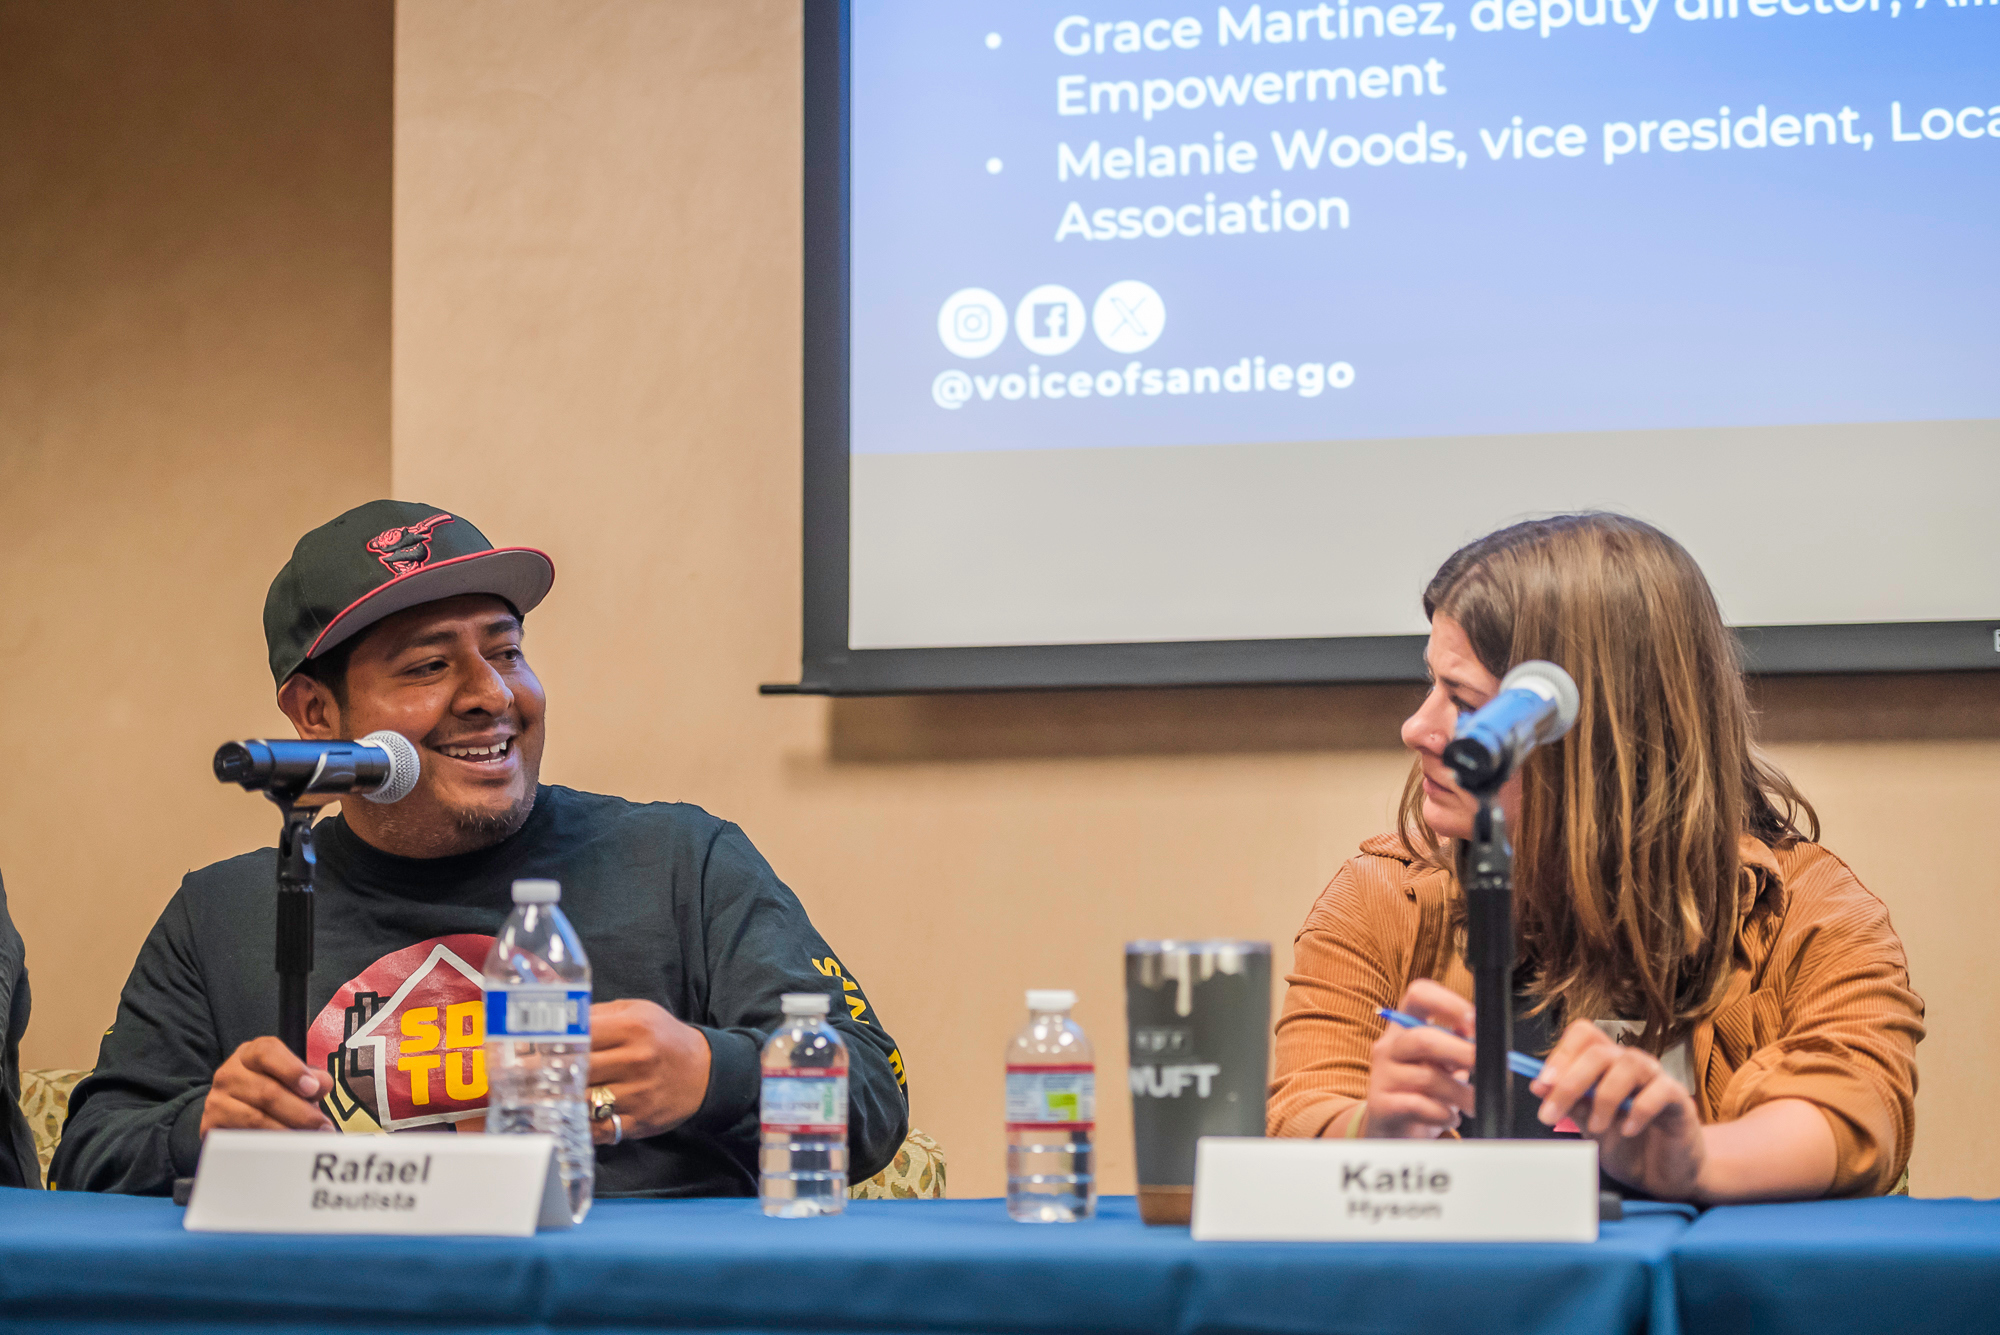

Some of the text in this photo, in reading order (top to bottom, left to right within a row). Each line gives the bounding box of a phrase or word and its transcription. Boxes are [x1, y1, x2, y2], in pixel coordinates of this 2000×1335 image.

[1055, 16, 1202, 55] Grace
[1219, 0, 1456, 41] Martinez,
[1470, 0, 1658, 38] deputy
[1058, 58, 1447, 121] Empowerment
[1058, 131, 1258, 181] Melanie
[1272, 121, 1467, 170] Woods,
[1480, 116, 1588, 160] vice
[1603, 105, 1873, 164] president,
[1055, 190, 1350, 241] Association
[932, 356, 1355, 408] @voiceofsandiego
[400, 1001, 485, 1053] SD
[398, 1050, 488, 1105] TU
[311, 1152, 433, 1184] Rafael
[1341, 1162, 1451, 1194] Katie
